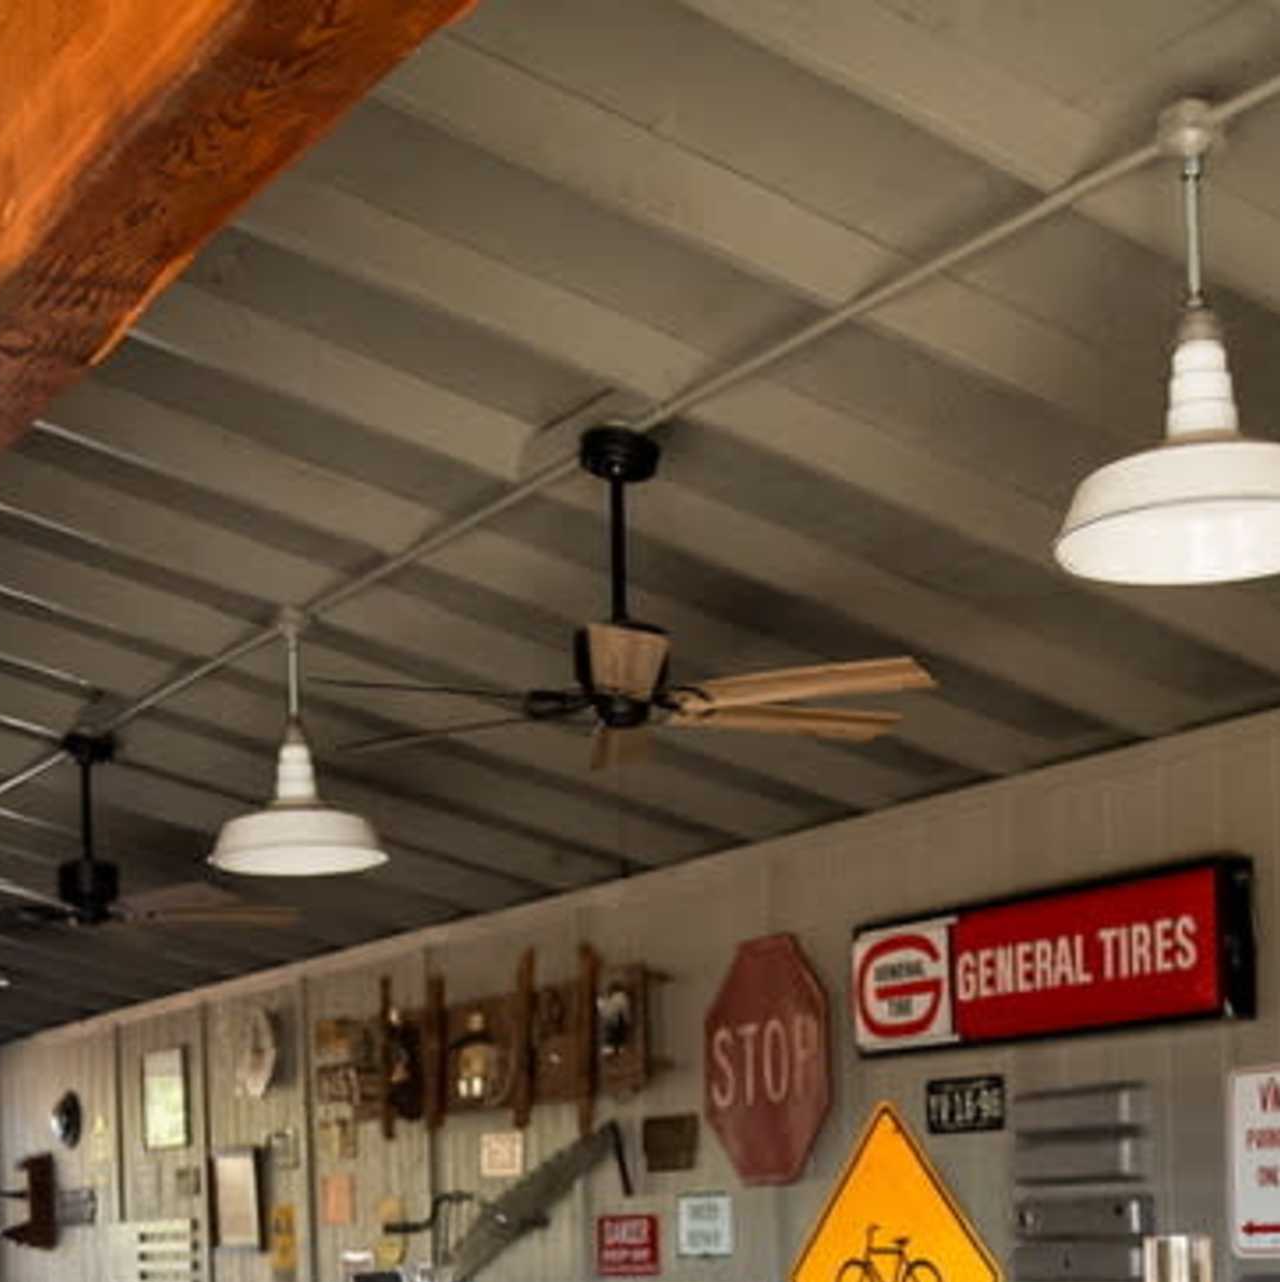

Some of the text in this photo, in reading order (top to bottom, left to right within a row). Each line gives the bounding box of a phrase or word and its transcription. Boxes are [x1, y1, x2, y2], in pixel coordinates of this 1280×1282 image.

[957, 914, 1198, 1002] GENERAL TIRES
[712, 1012, 819, 1108] STOP
